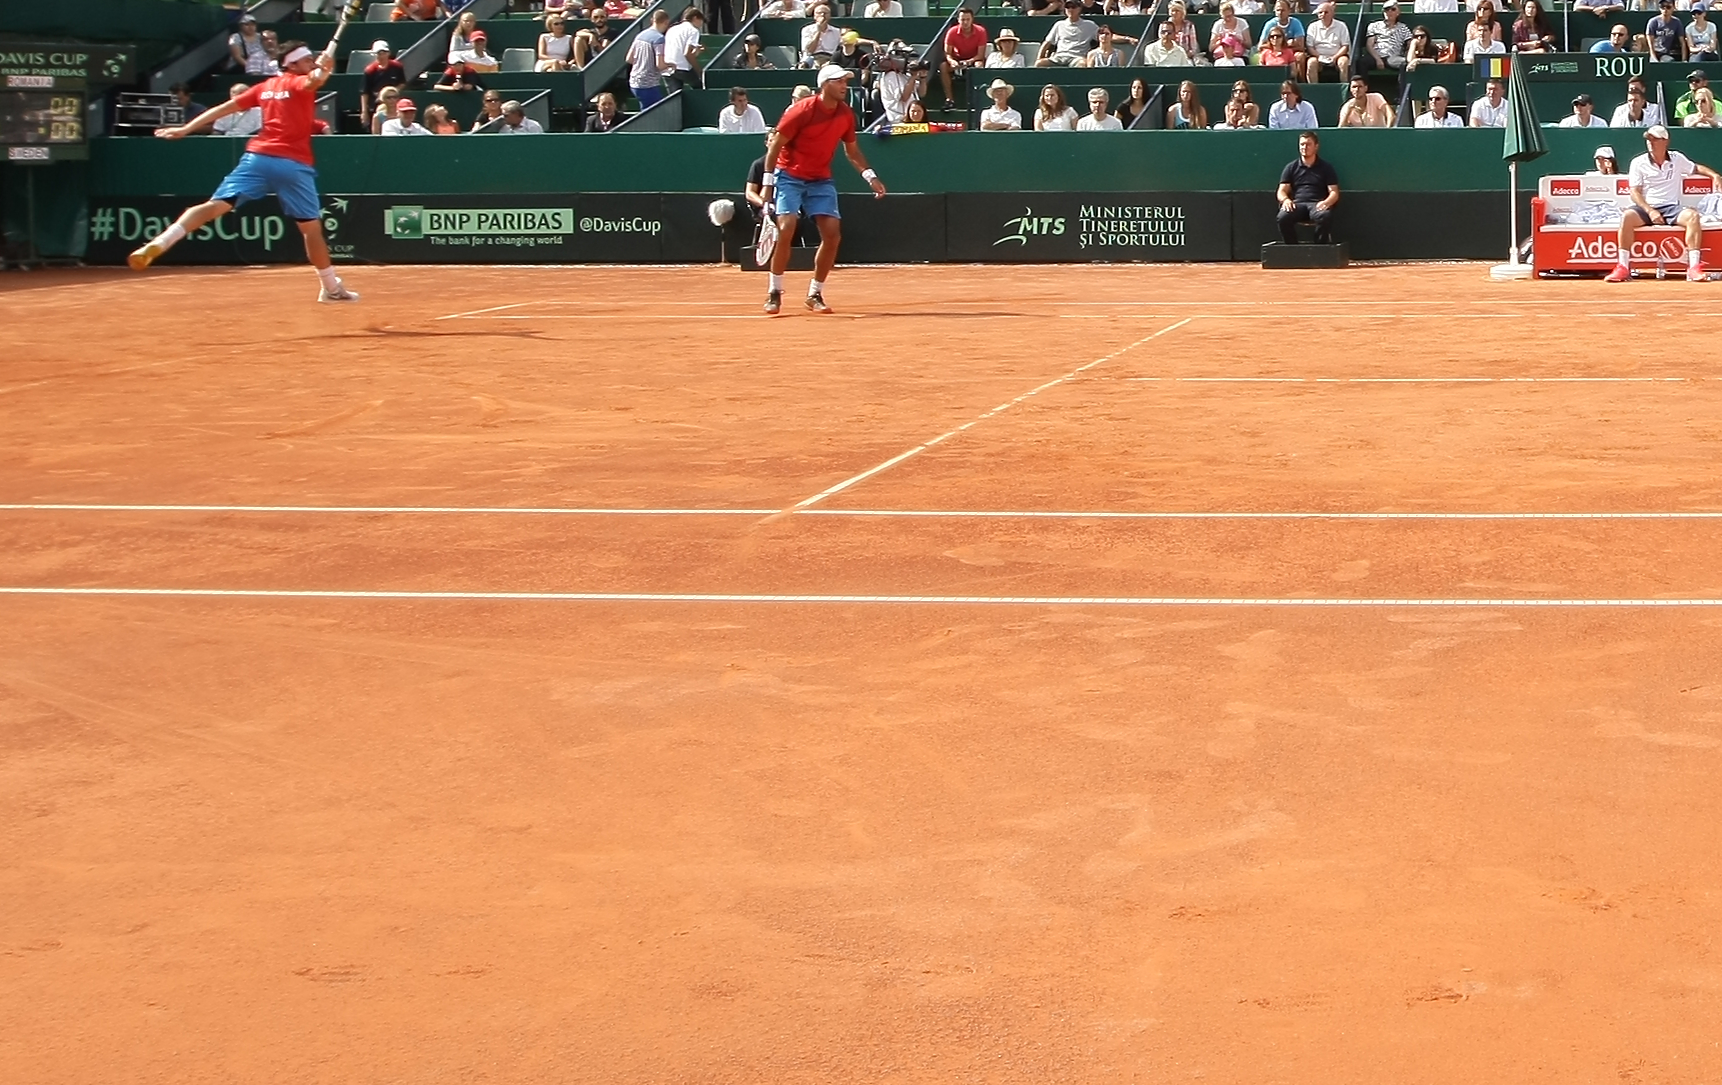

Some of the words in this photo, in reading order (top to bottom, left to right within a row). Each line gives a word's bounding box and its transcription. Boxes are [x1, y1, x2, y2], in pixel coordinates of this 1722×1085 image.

[49, 52, 89, 65] CUP
[32, 68, 87, 77] PARIBAS
[1595, 57, 1644, 76] ROU
[1553, 187, 1579, 195] Adecco
[1685, 186, 1711, 194] Adecco
[1079, 205, 1185, 219] MINISTERUL
[429, 213, 470, 231] BNP
[477, 212, 563, 231] PARIBAS
[579, 217, 661, 235] @DavisCup
[1018, 217, 1066, 235] MTS
[1079, 219, 1184, 232] TINERETULUI
[90, 207, 284, 251] #DasCup
[430, 236, 446, 245] The
[448, 236, 470, 245] bank
[471, 236, 486, 246] for
[494, 236, 535, 246] changing
[537, 236, 563, 245] world
[1099, 232, 1185, 246] SPORTULUI
[1569, 235, 1658, 259] Adeco
